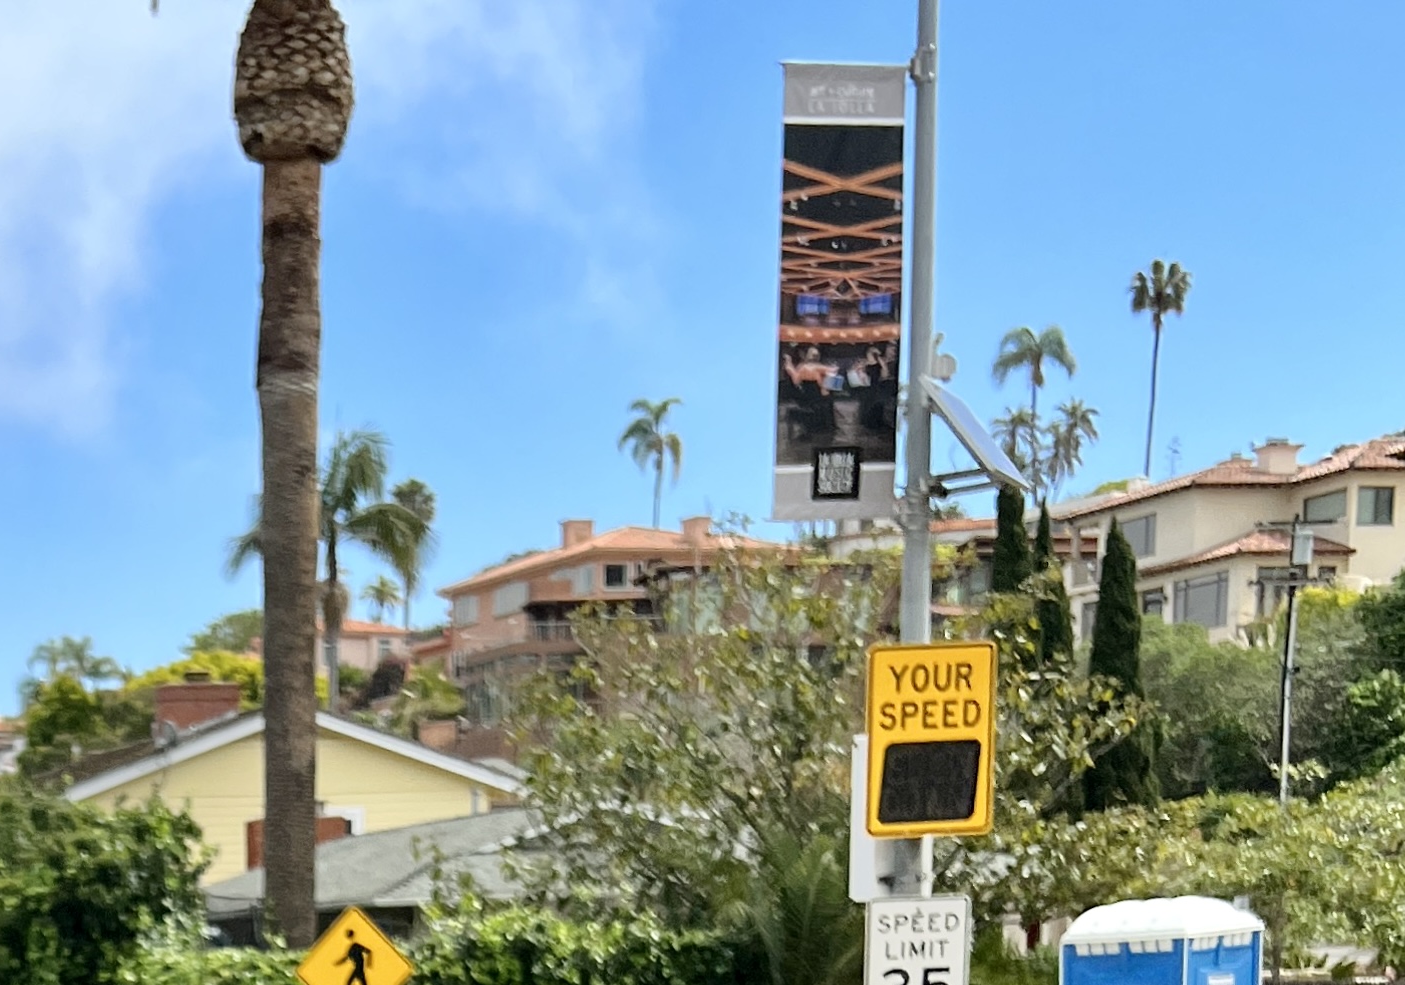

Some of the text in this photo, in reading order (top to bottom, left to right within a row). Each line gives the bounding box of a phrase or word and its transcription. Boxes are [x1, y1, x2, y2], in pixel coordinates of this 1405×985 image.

[889, 662, 974, 694] YOUR
[878, 699, 982, 732] SPEED
[877, 911, 960, 934] SPEED
[884, 938, 951, 961] LIMIT
